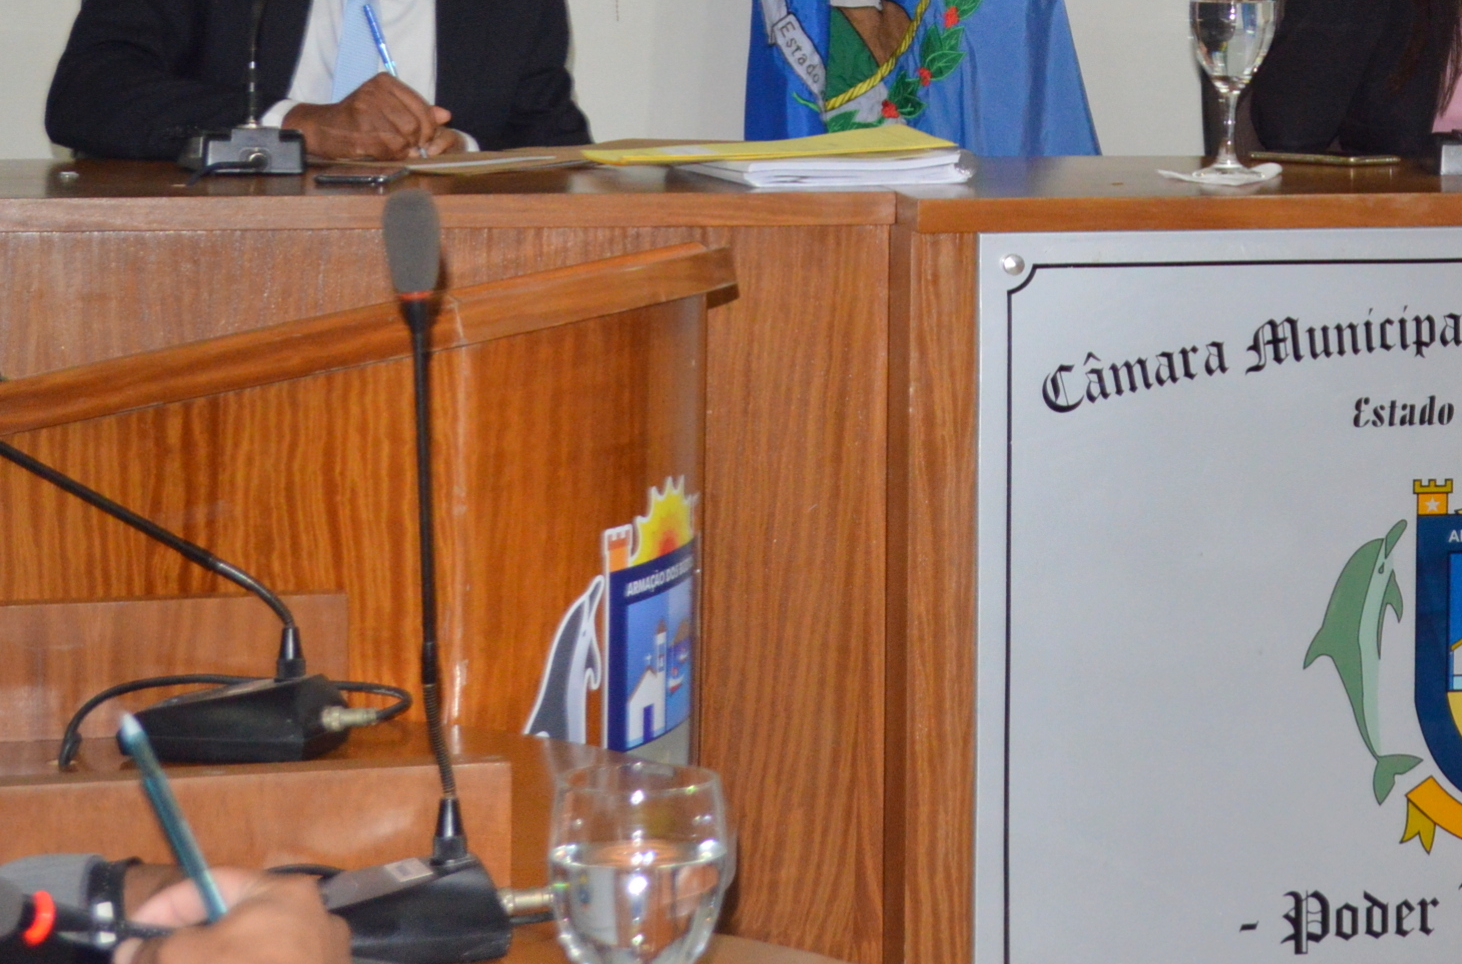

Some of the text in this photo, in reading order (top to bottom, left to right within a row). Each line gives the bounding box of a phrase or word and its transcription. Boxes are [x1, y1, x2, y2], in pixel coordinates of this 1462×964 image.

[778, 20, 820, 84] Estado
[1041, 340, 1230, 414] Câmara
[1352, 395, 1455, 429] Estado
[625, 569, 665, 597] ARMAÇÃO
[1280, 888, 1440, 955] Poder
